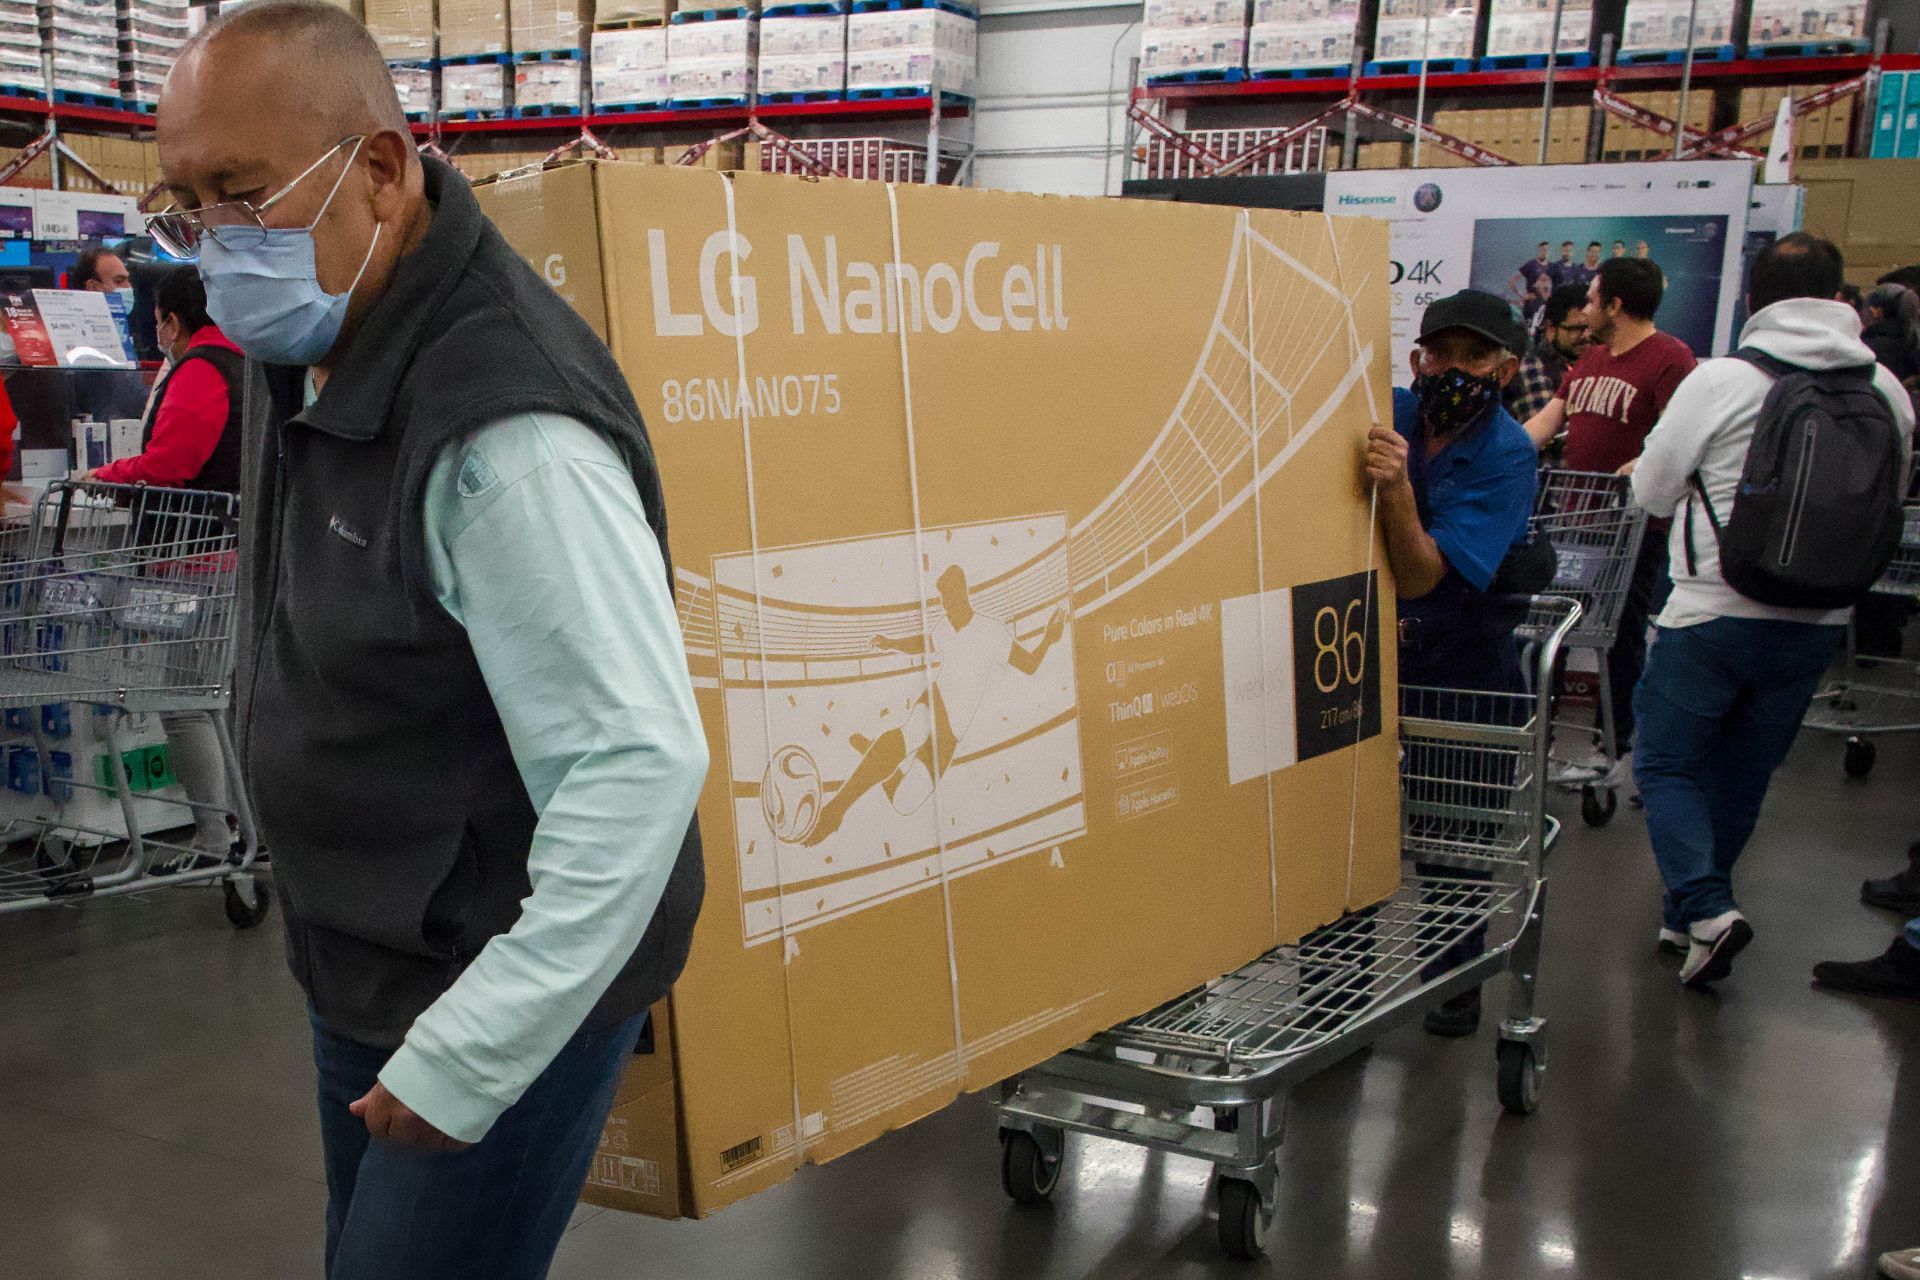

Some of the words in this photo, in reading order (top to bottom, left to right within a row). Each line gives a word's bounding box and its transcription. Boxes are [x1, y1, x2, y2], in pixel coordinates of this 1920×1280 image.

[1338, 194, 1397, 205] Hisense
[647, 229, 759, 337] LG
[787, 234, 1068, 334] NanoCell
[662, 374, 841, 423] 86NANO75
[1103, 623, 1128, 642] Pure
[1129, 618, 1163, 638] Colors
[1164, 615, 1174, 631] in
[1175, 606, 1198, 628] Real
[1314, 599, 1365, 694] 86
